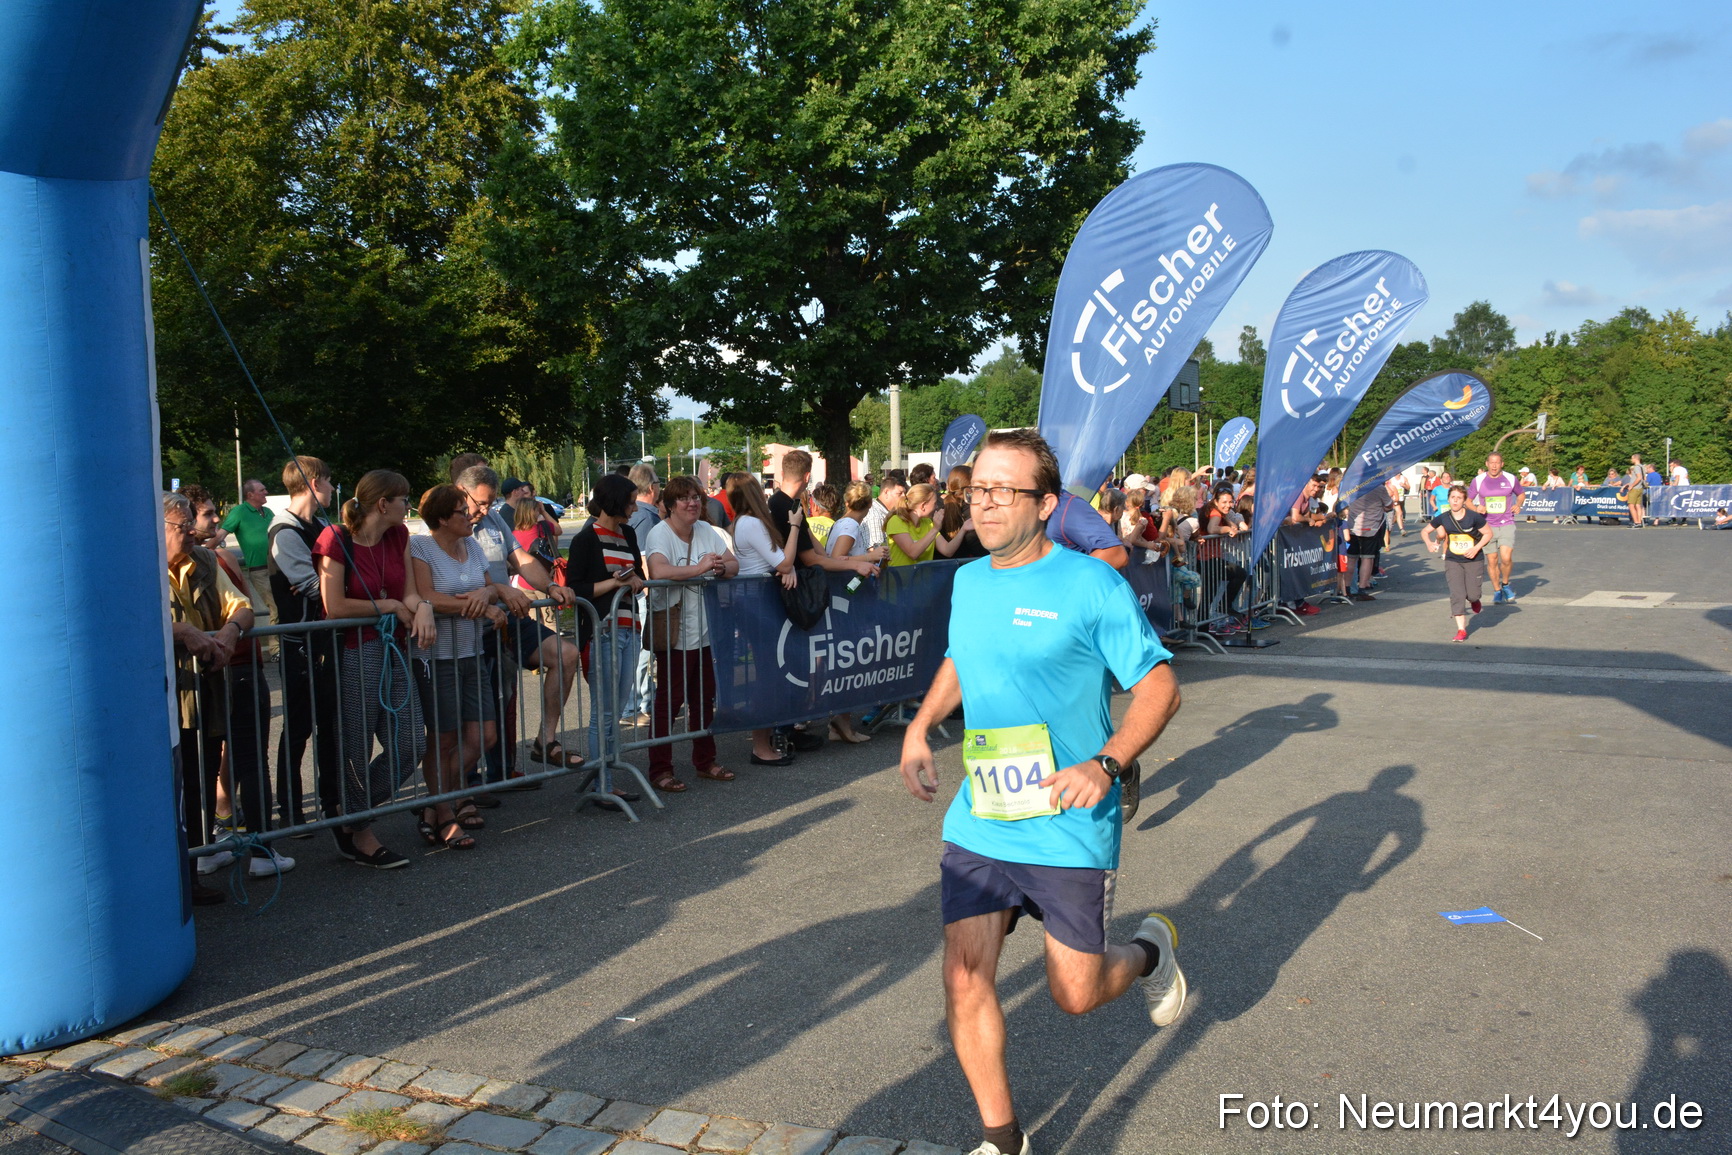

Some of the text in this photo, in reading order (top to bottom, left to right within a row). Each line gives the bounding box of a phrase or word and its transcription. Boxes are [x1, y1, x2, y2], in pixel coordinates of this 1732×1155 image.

[1100, 202, 1223, 367] Fischer
[1144, 234, 1237, 365] AUTOMOBILE
[1302, 276, 1391, 398] Fischer
[1333, 297, 1403, 396] AUTOMOBILE
[951, 422, 977, 460] Fischer
[1224, 423, 1247, 457] Fischer
[1361, 411, 1454, 467] Frischmann
[1421, 428, 1444, 443] Druck
[1458, 404, 1486, 424] Medien
[1522, 498, 1558, 507] Fischer
[1681, 497, 1732, 508] Fischer
[1283, 546, 1324, 568] Frischmann
[1012, 618, 1032, 627] Klaus
[809, 624, 923, 674] Fischer
[820, 662, 915, 696] AUTOMOBILE
[974, 761, 1046, 794] 1104
